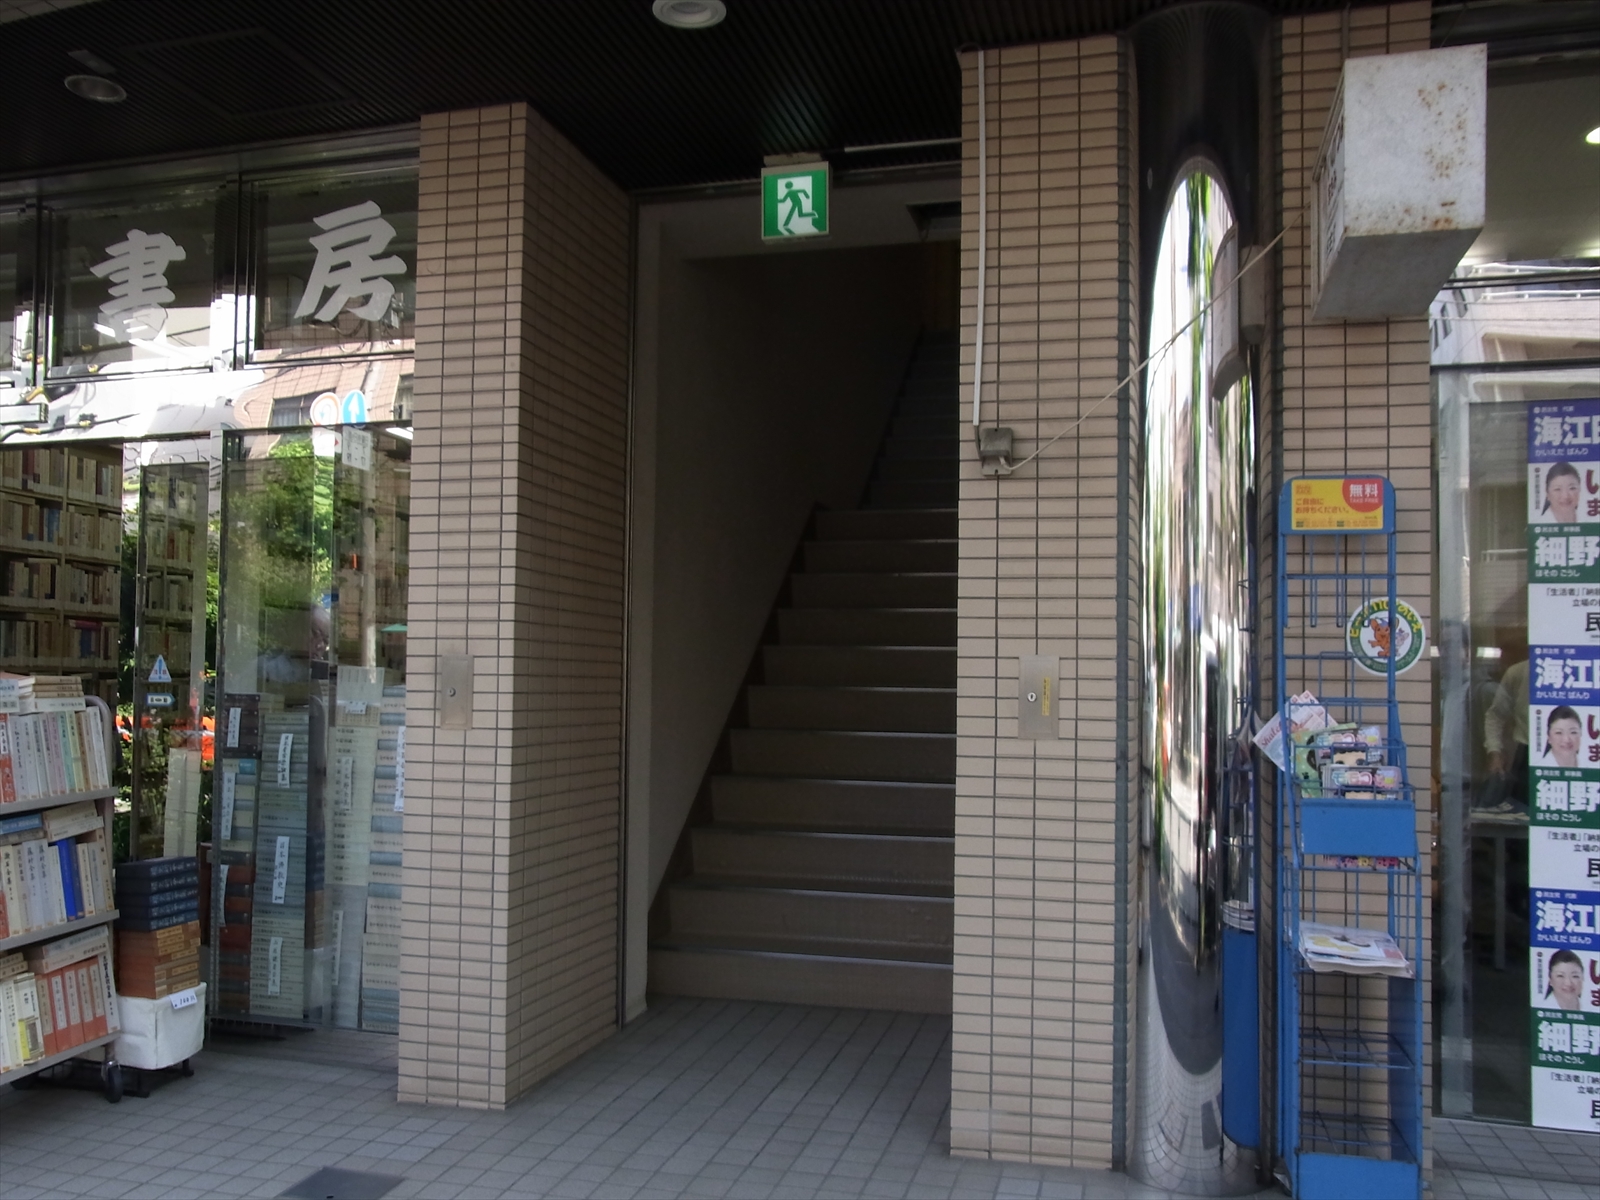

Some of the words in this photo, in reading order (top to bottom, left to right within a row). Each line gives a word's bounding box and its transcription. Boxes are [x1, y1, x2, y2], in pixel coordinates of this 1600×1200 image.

[1535, 448, 1565, 456] かいえだ
[1567, 447, 1589, 455] ばんり
[1350, 483, 1378, 497] 無料
[1295, 506, 1349, 514] お持ちください。
[1535, 535, 1600, 567] 細野
[1535, 569, 1558, 577] ほその
[1560, 569, 1580, 577] ごうし
[1573, 599, 1600, 607] 立場の
[1535, 657, 1600, 689] 海江
[1536, 779, 1600, 812] 細野
[1536, 812, 1559, 821] ほその
[1561, 813, 1582, 822] ごうし
[1536, 900, 1600, 934] 海江
[1538, 1020, 1600, 1055] 細野
[1538, 1053, 1562, 1062] ほその
[1564, 1054, 1585, 1064] ごうし
